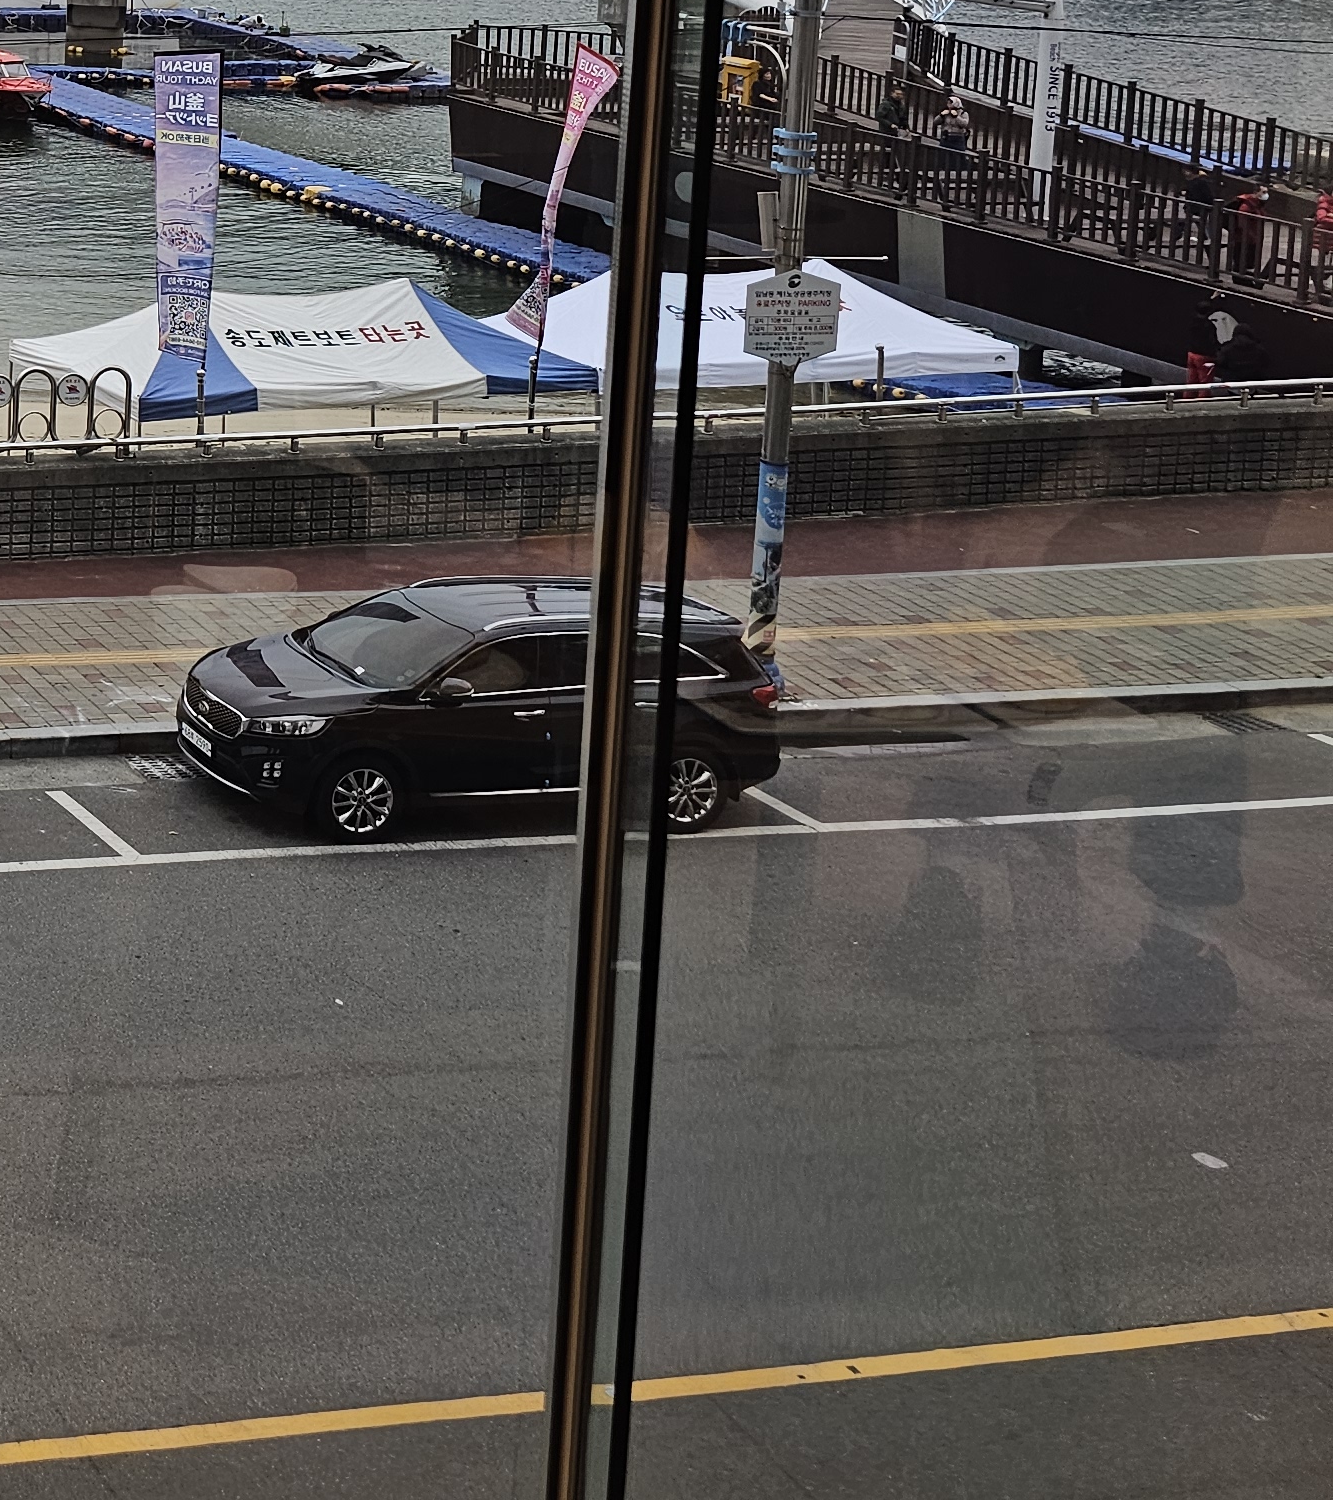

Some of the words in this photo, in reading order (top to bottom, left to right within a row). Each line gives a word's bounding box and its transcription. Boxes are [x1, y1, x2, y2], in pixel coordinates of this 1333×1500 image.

[1047, 65, 1060, 100] SINCE
[1044, 105, 1056, 133] 1913
[798, 299, 831, 307] PARKING
[225, 327, 361, 348] 송도제트보트
[358, 320, 431, 344] 타는곳
